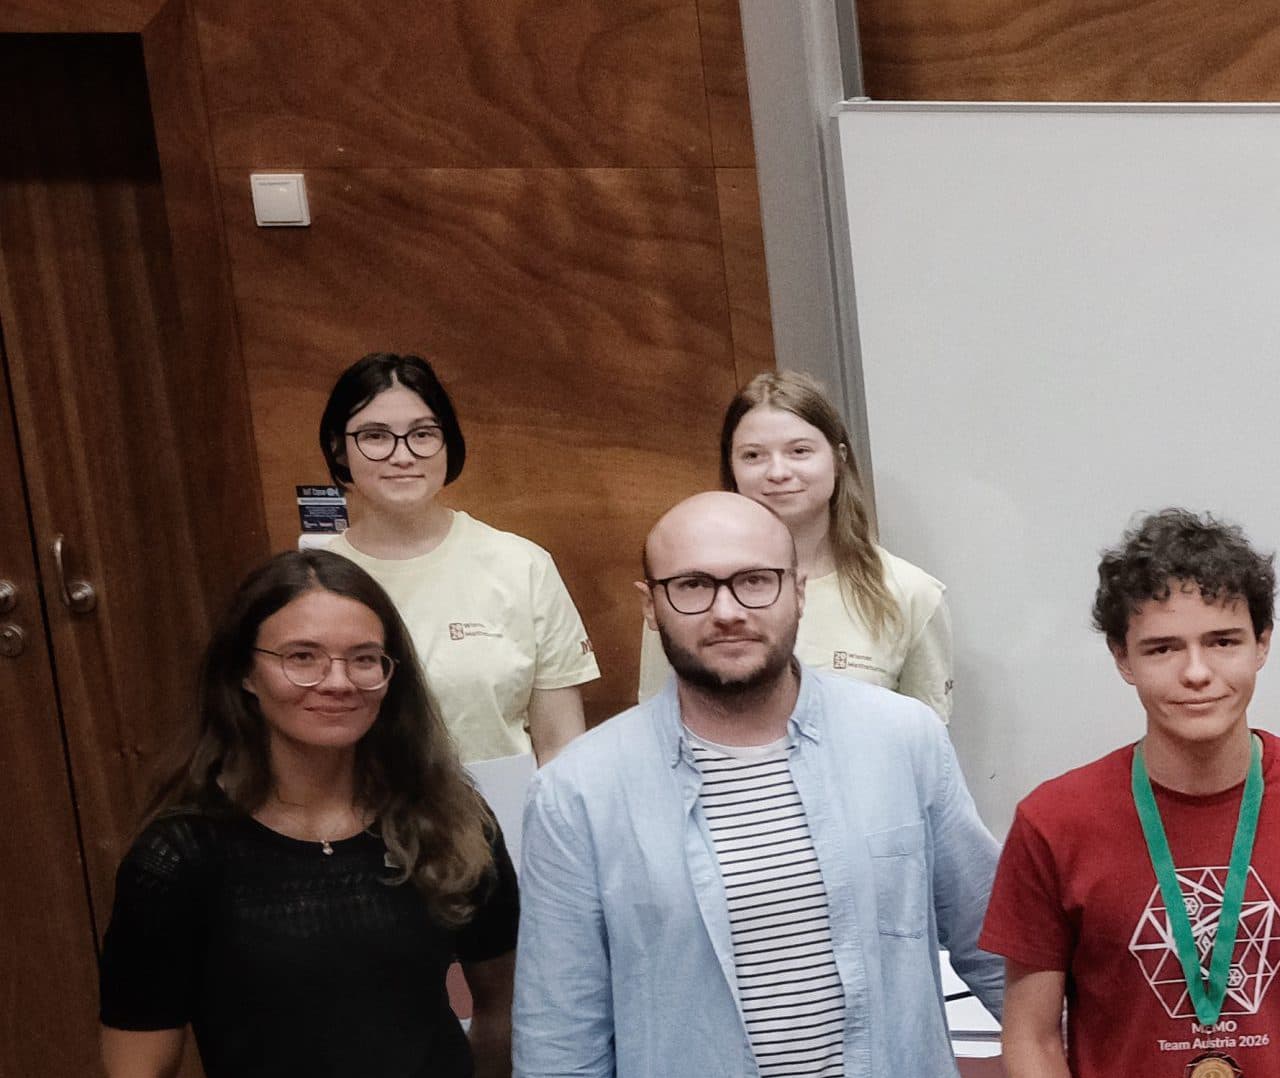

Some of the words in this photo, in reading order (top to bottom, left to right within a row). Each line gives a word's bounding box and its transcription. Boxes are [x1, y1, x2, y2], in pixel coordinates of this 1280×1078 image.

[1157, 1040, 1191, 1051] Team
[1192, 1037, 1236, 1049] Austria
[1238, 1034, 1270, 1047] 2026
